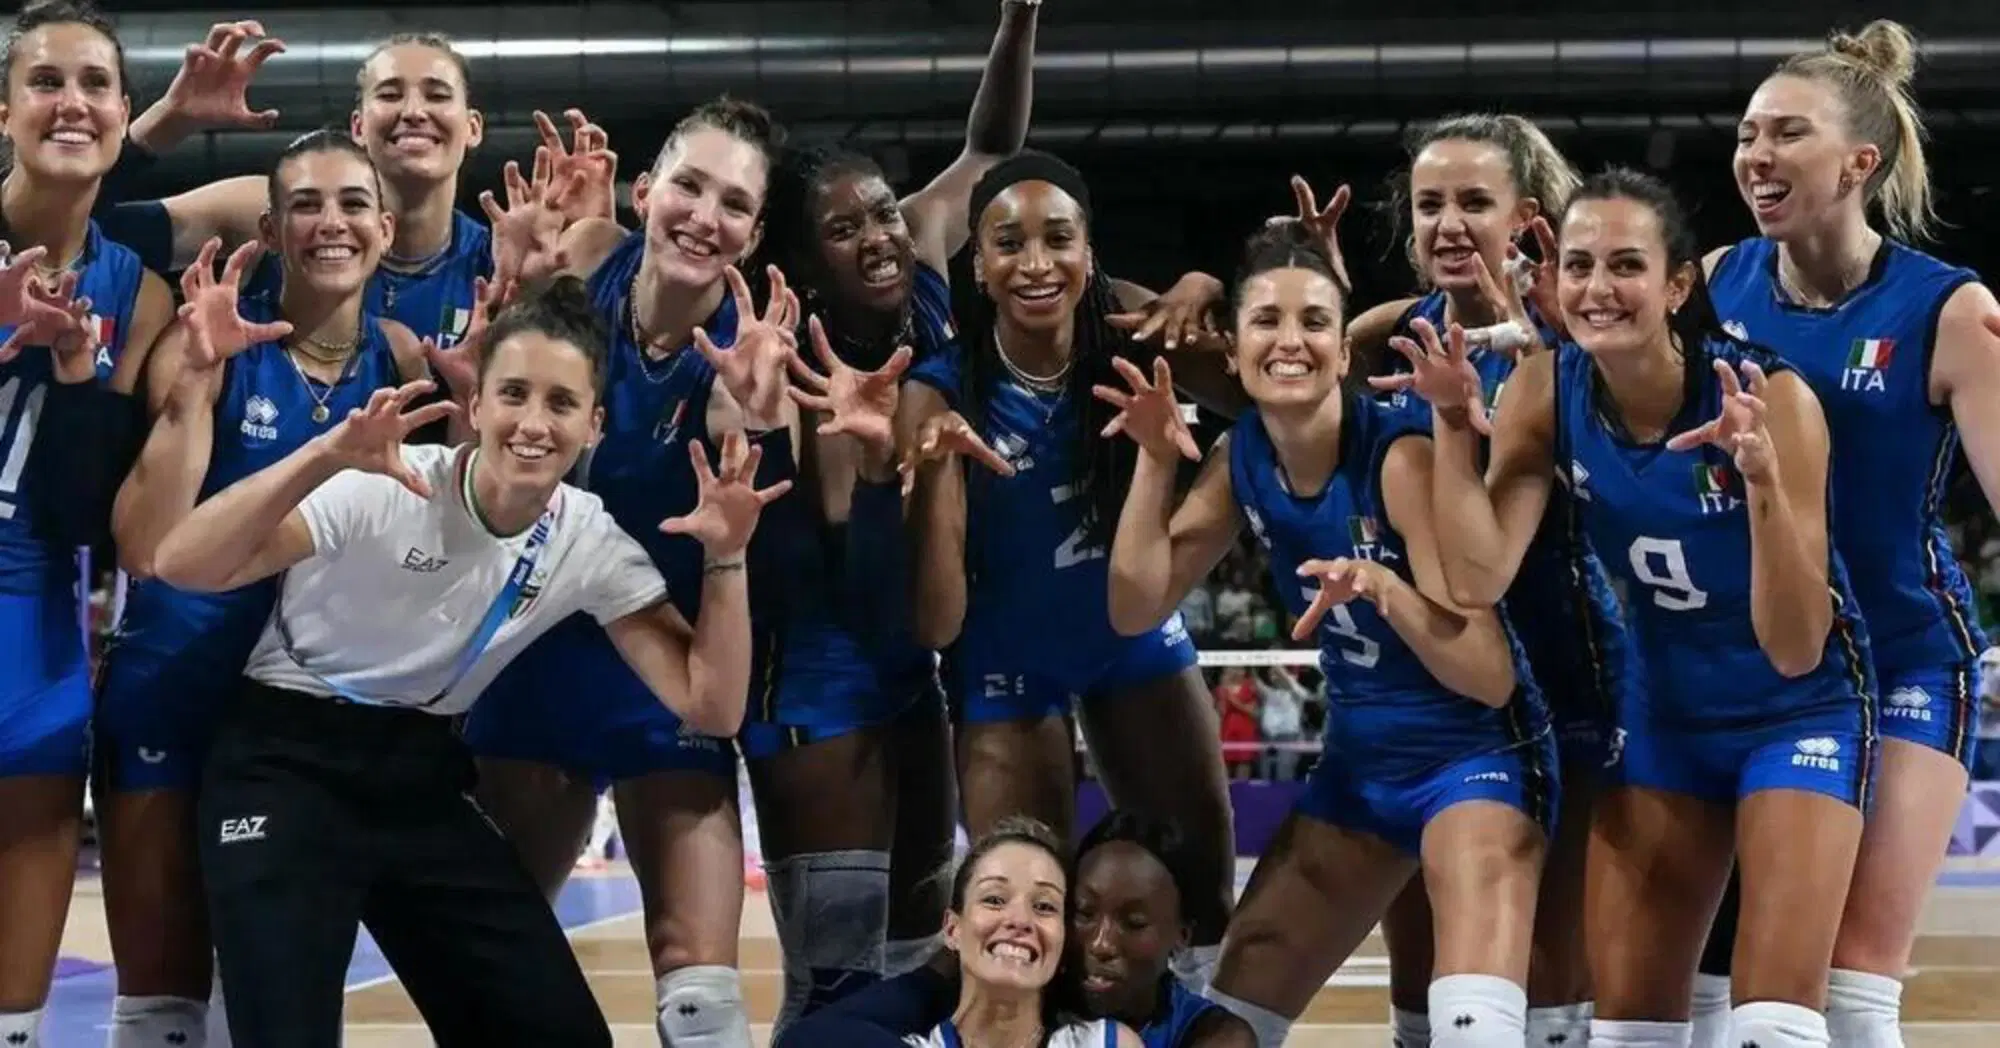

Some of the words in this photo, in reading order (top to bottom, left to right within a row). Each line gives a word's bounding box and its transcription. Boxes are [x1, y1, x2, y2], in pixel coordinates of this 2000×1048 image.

[1841, 367, 1885, 392] ITA
[1628, 536, 1708, 611] 9
[221, 815, 268, 840] EA7
